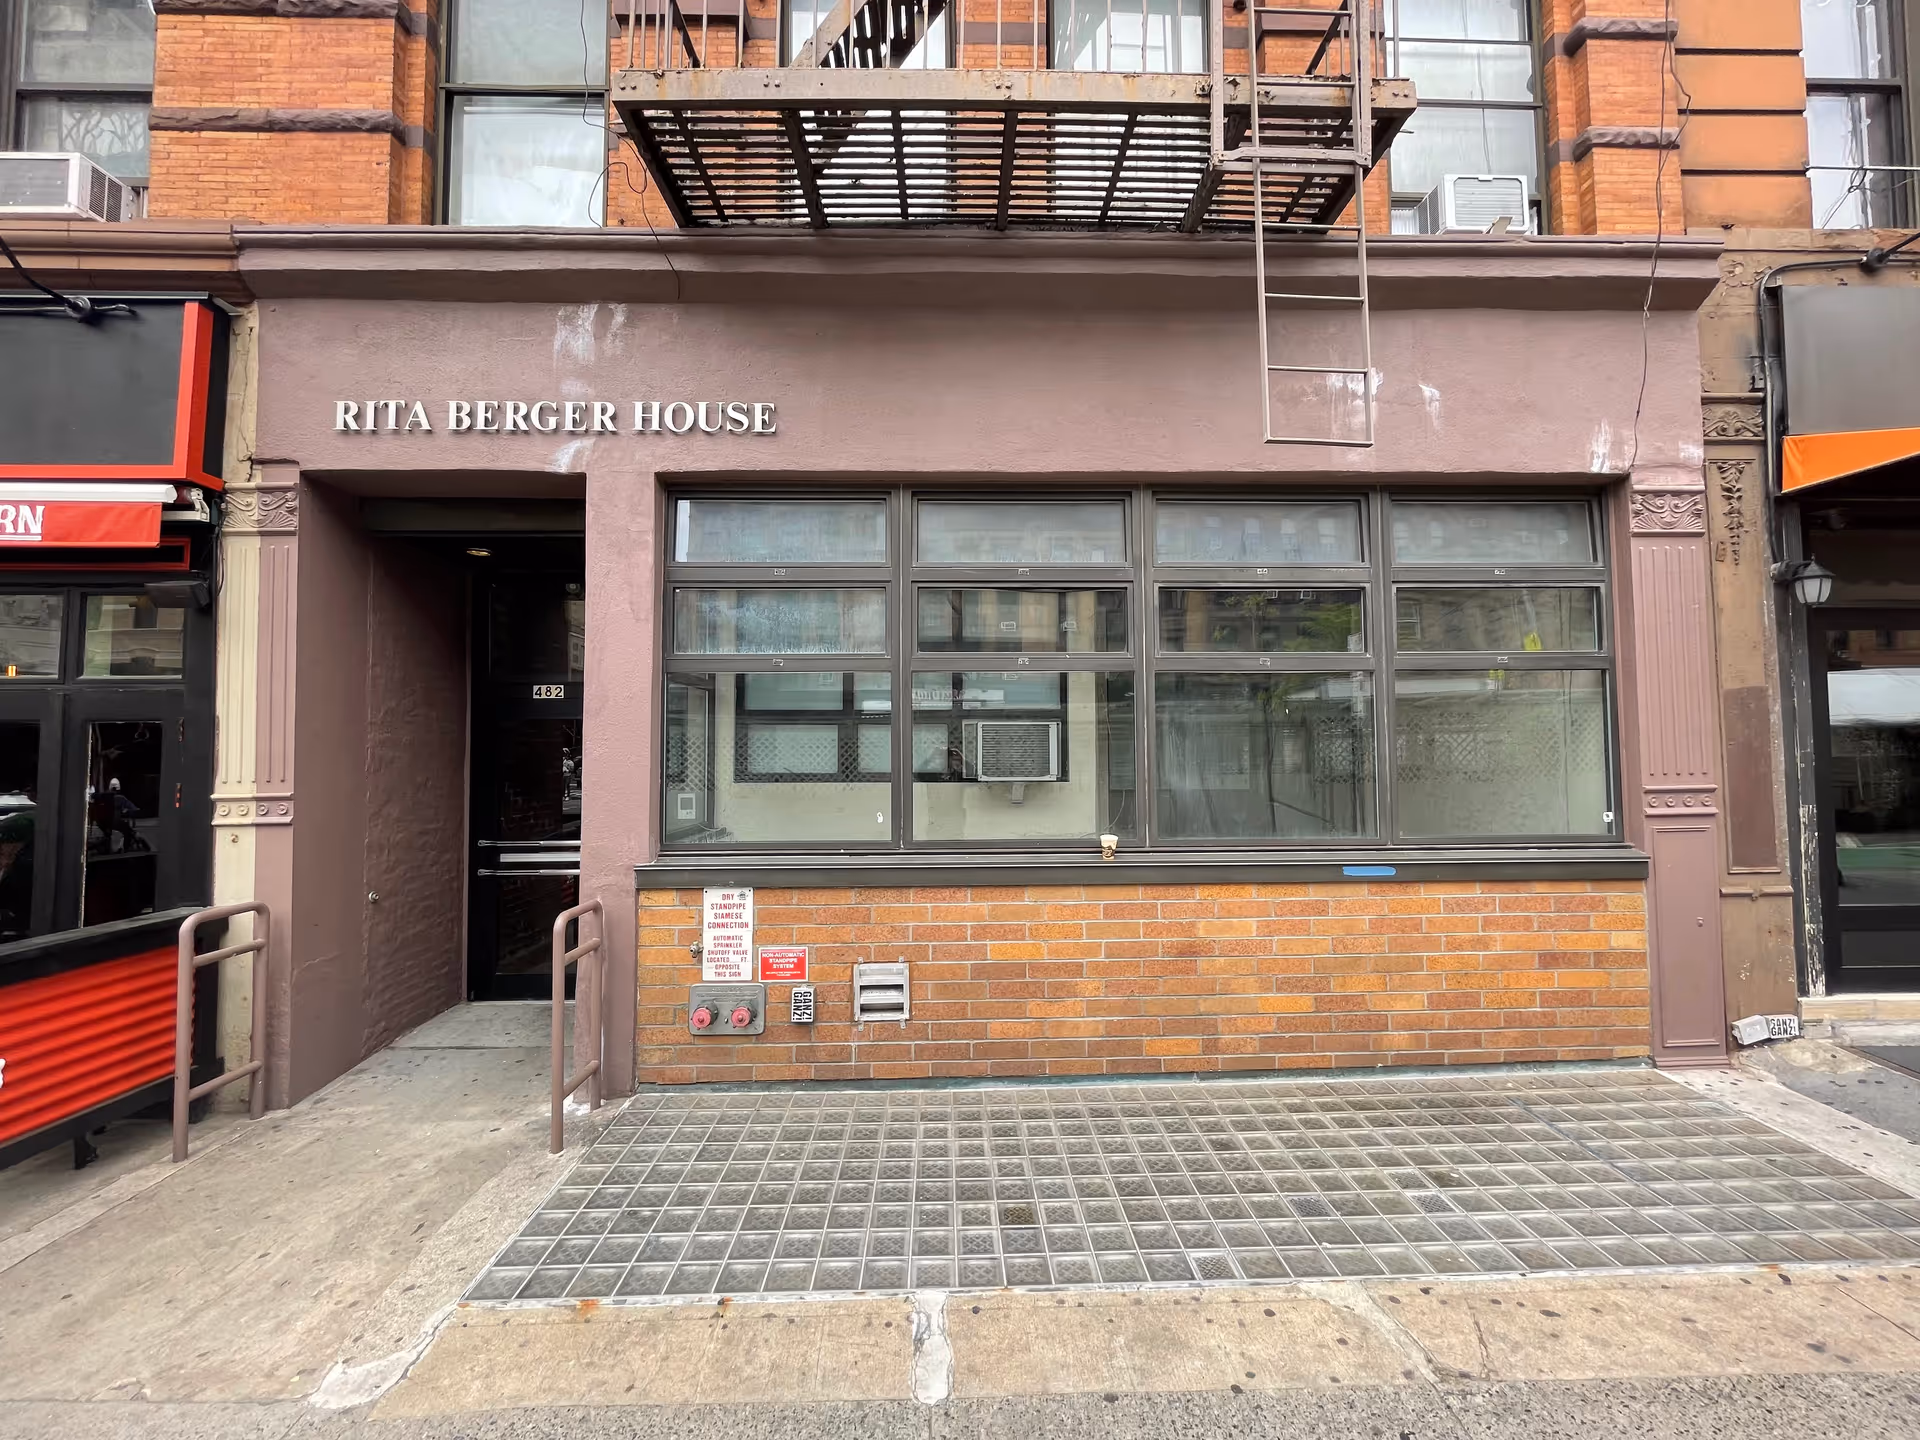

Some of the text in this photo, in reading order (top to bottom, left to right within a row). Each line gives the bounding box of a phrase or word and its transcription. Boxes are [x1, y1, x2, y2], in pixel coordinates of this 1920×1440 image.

[332, 399, 777, 433] RITA BERGER HOUSE
[534, 686, 563, 697] 482
[721, 893, 735, 901] DRY
[792, 991, 803, 1020] GANZ!
[802, 991, 812, 1020] GANZ!
[1771, 1026, 1797, 1036] GANZ!
